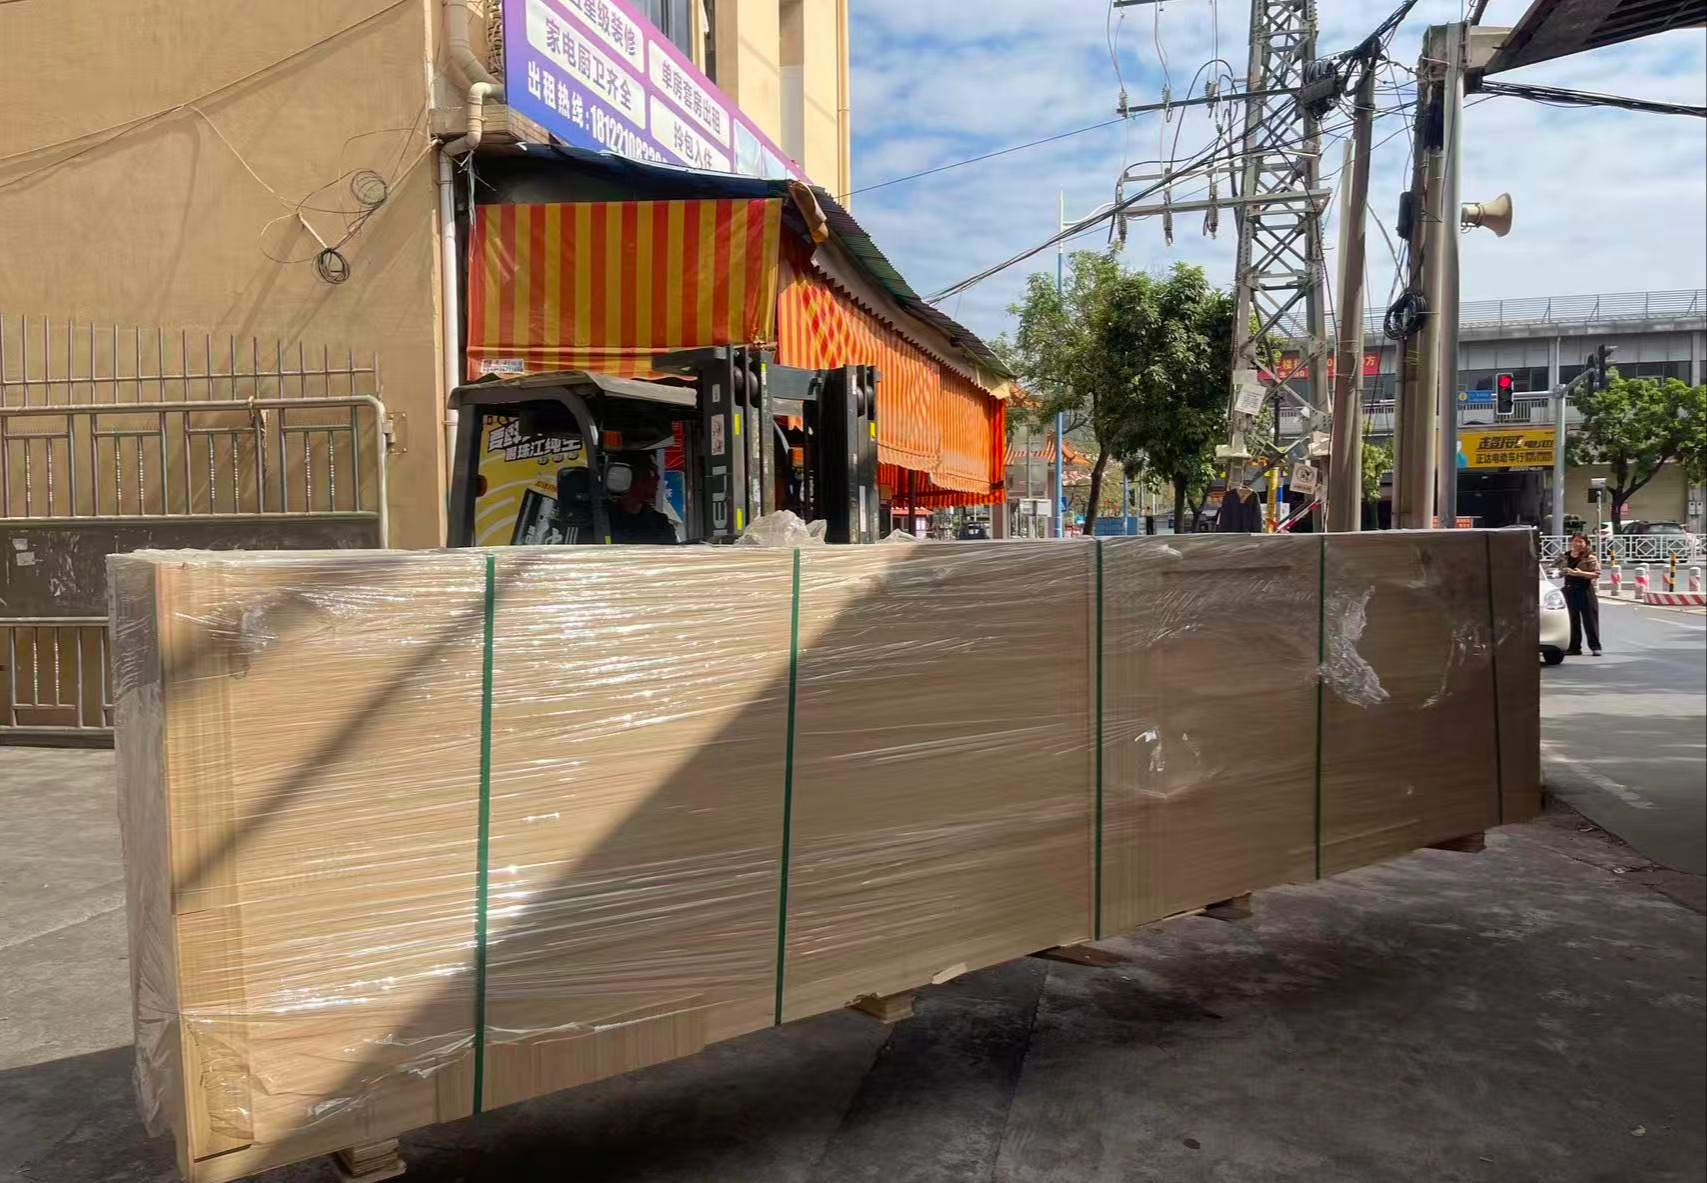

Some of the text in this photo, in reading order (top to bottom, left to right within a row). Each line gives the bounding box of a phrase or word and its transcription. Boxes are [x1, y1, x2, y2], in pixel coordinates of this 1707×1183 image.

[545, 17, 632, 111] 家电厨卫齐全
[662, 60, 720, 136] 单房套房出租
